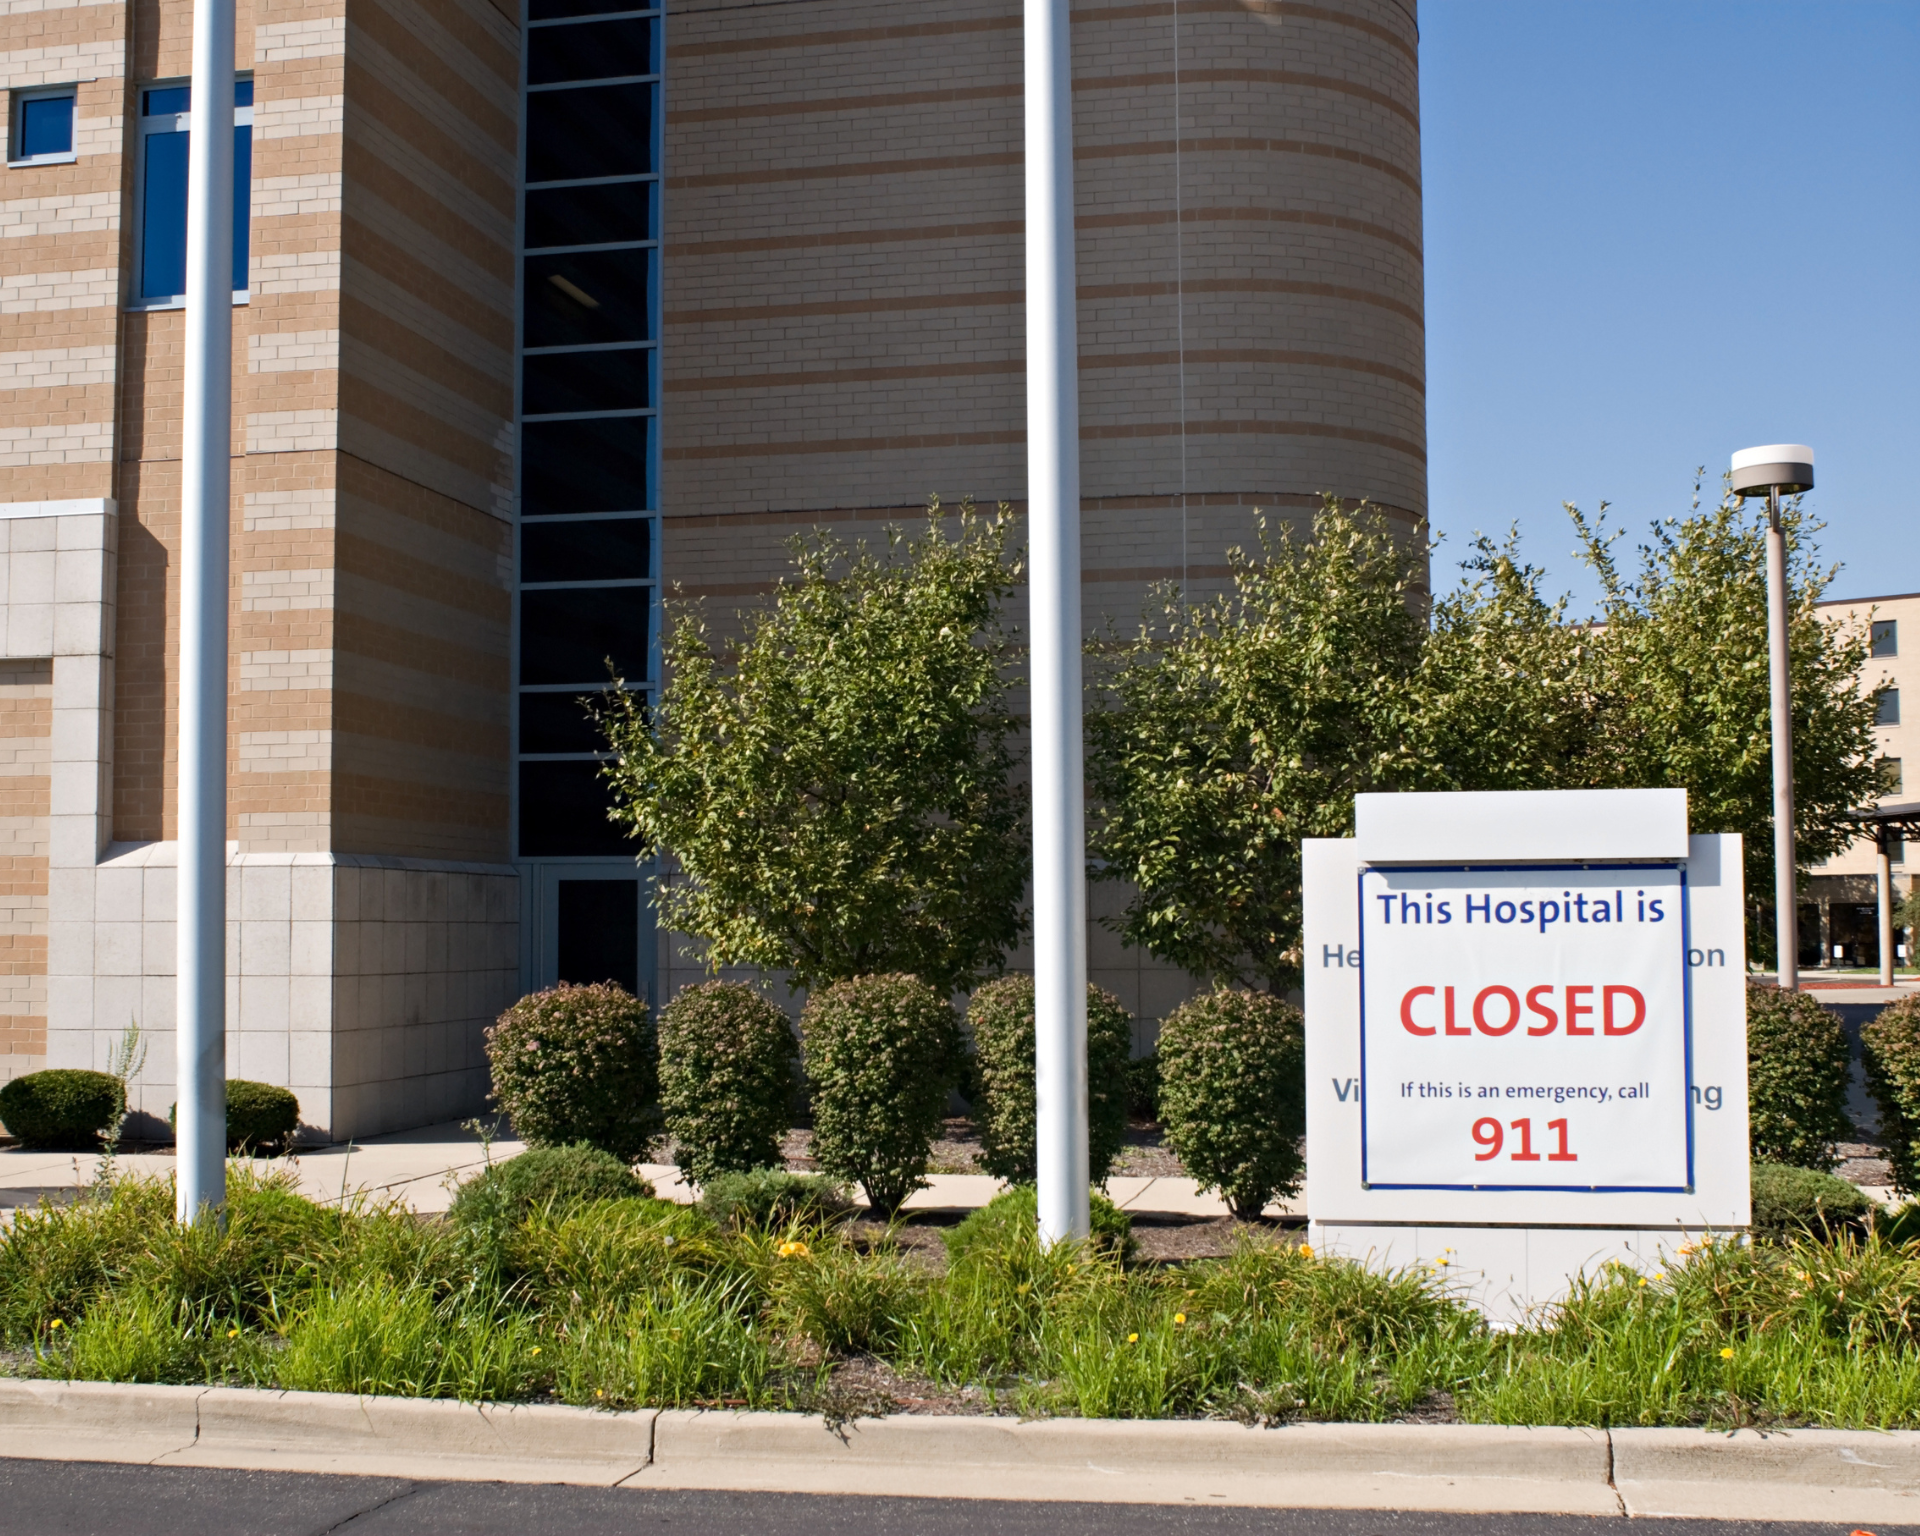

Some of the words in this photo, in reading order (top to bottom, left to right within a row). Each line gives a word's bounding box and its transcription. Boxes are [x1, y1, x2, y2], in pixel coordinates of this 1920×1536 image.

[1377, 891, 1452, 924] This
[1465, 890, 1623, 933] Hospital
[1637, 890, 1664, 922] is
[1400, 985, 1646, 1036] CLOSED
[1401, 1082, 1415, 1098] If
[1418, 1082, 1453, 1098] this
[1458, 1082, 1472, 1098] is
[1478, 1086, 1500, 1098] an
[1505, 1086, 1612, 1104] emergency,
[1618, 1082, 1650, 1098] call
[1472, 1117, 1577, 1161] 911
